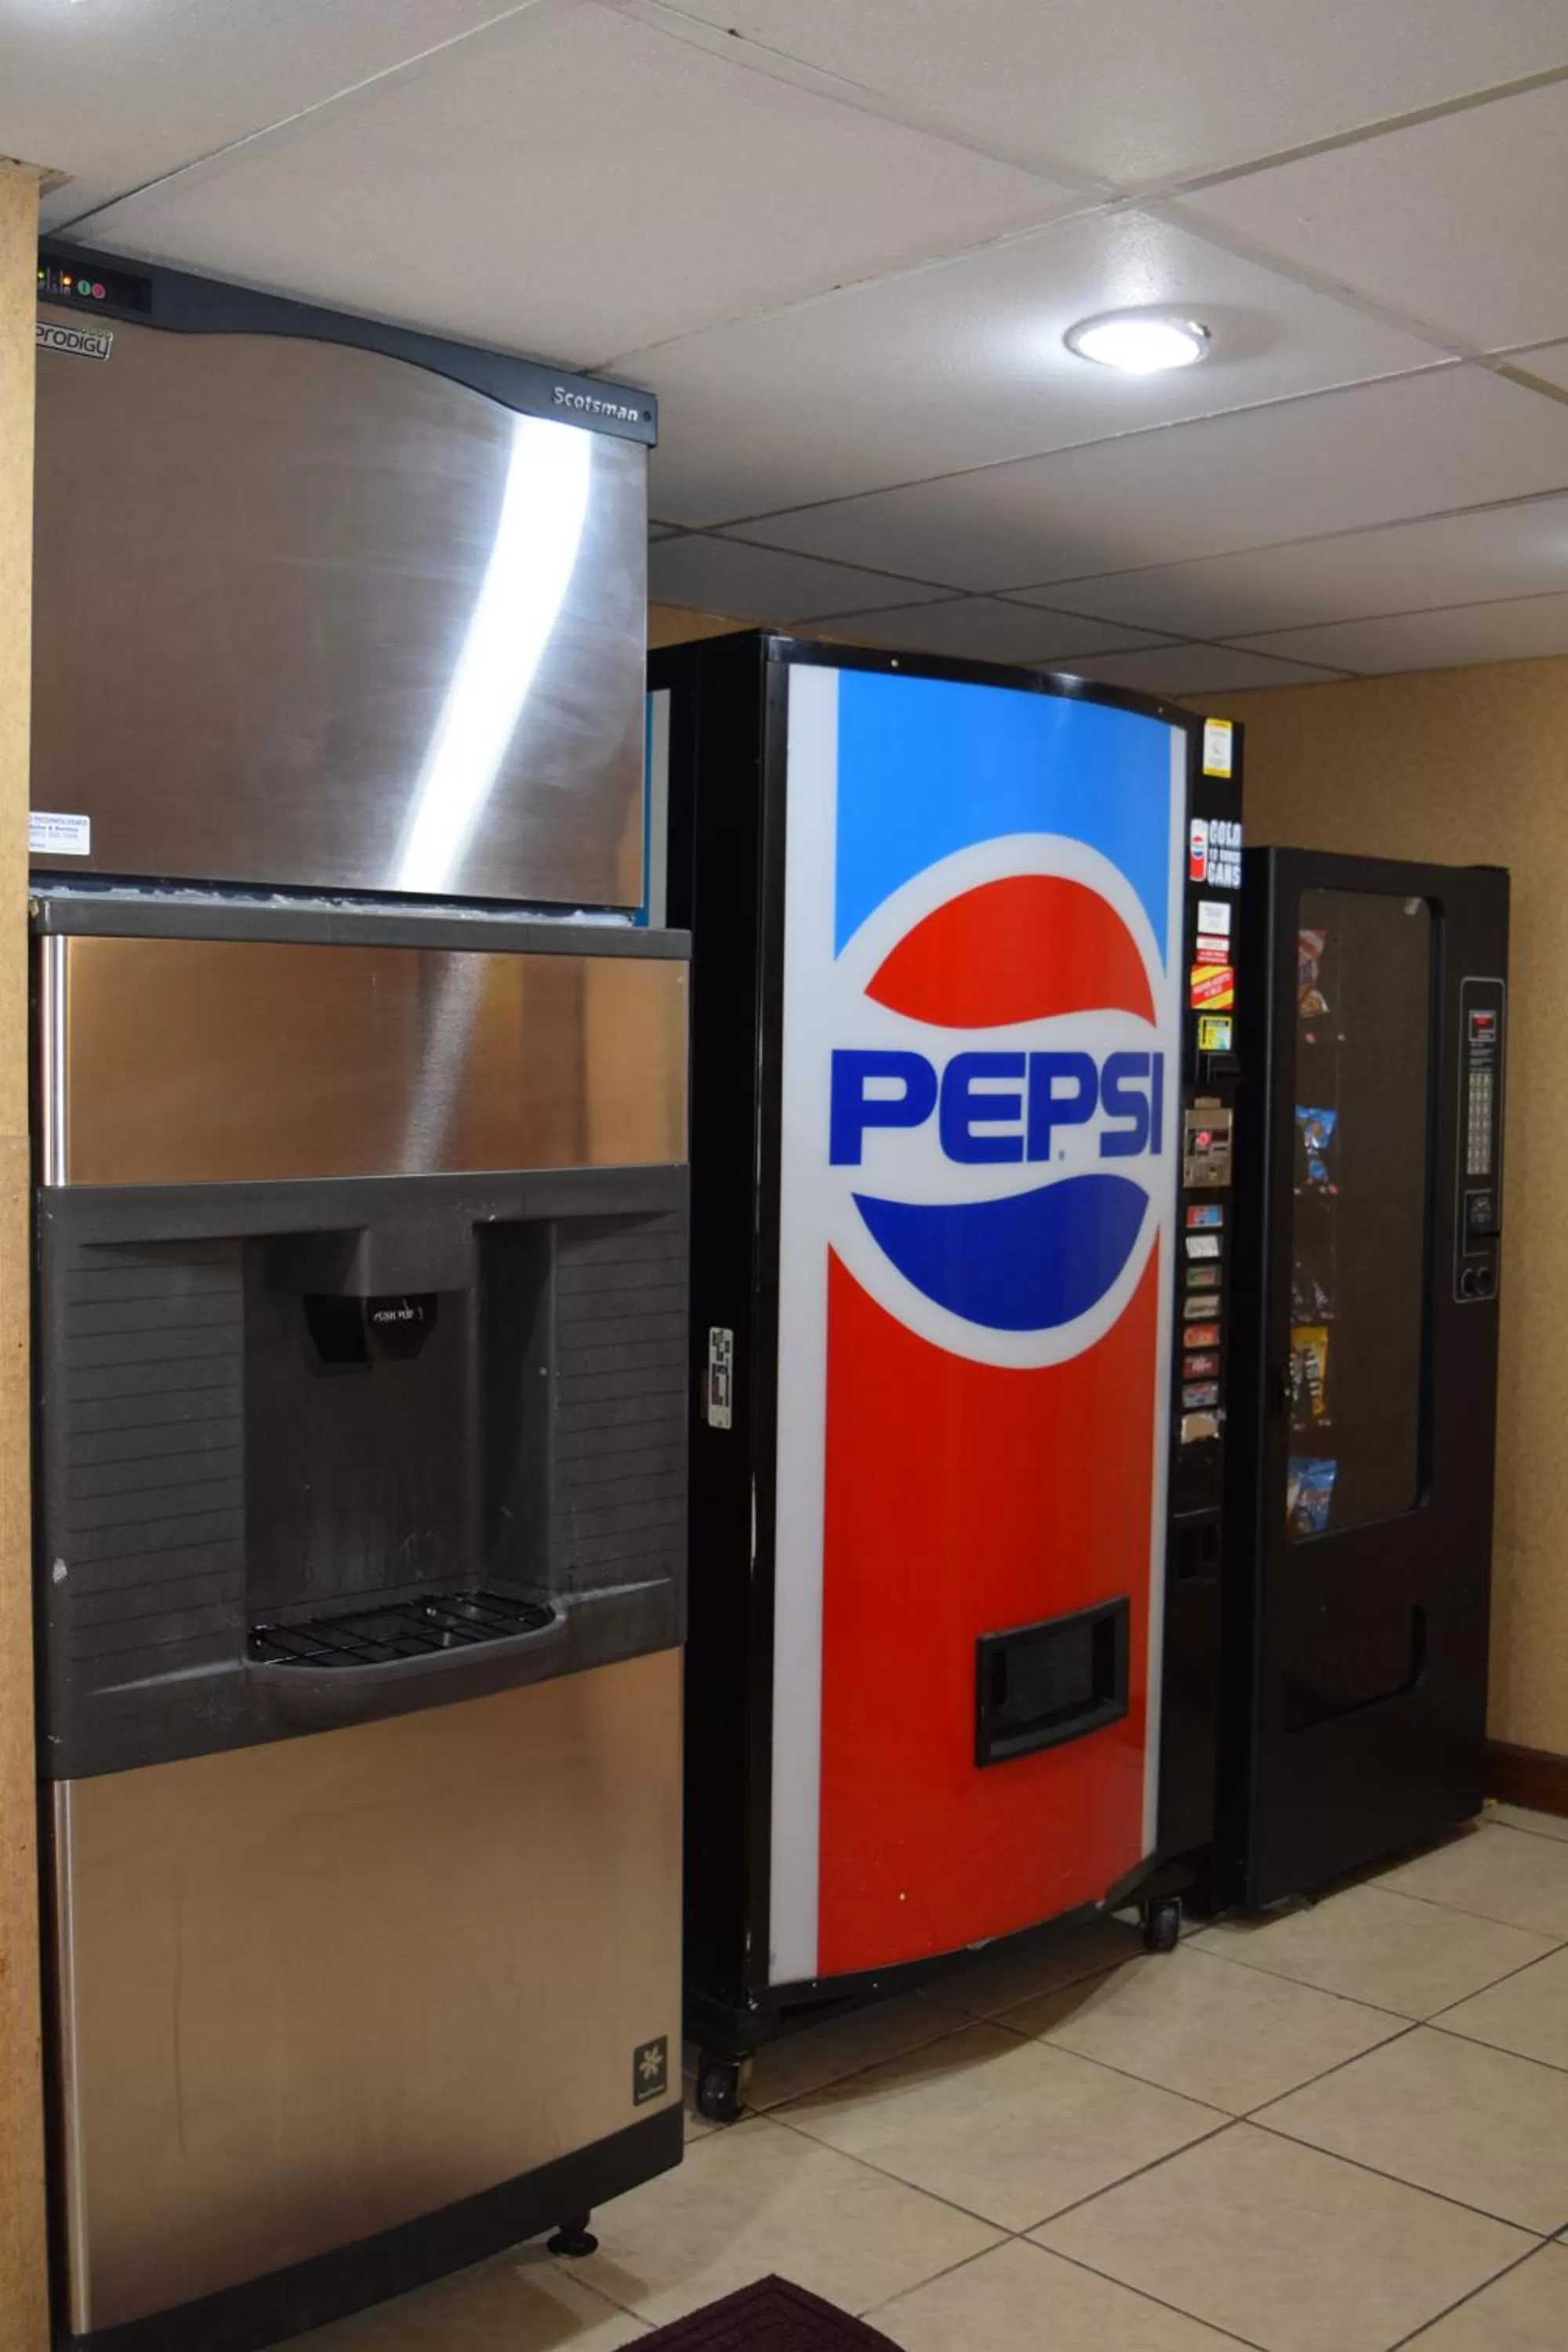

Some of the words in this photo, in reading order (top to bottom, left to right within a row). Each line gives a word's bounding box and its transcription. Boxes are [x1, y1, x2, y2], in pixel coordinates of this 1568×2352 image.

[553, 386, 639, 422] Scotsman
[1209, 819, 1242, 848] COLD
[1207, 862, 1242, 889] CANS
[829, 1048, 1165, 1167] PEPSI
